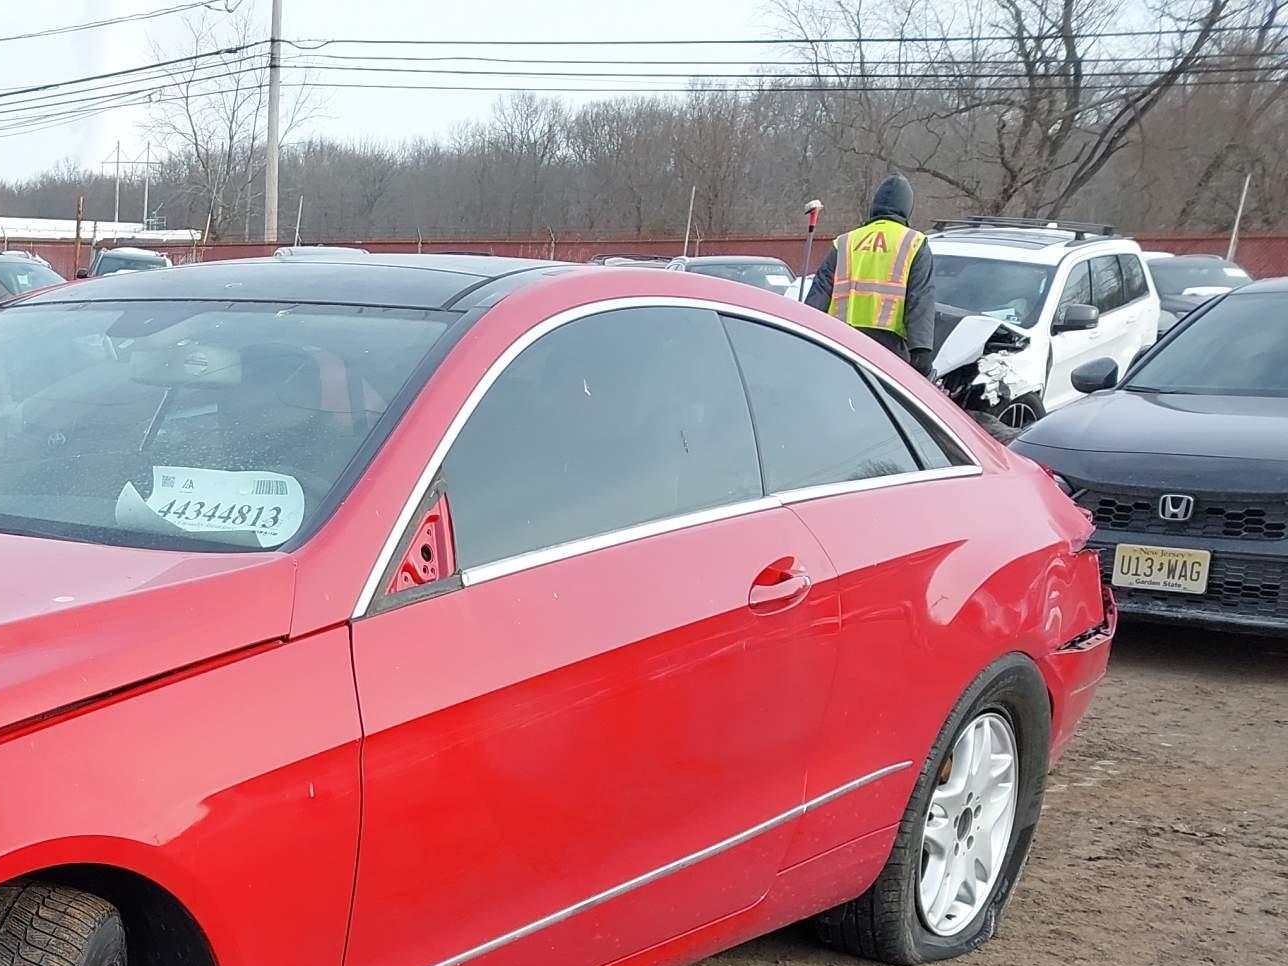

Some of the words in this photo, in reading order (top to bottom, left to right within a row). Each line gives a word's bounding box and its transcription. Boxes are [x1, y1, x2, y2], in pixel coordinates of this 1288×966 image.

[158, 499, 282, 528] 44344813
[1138, 547, 1158, 556] New
[1160, 549, 1185, 559] Jersey
[1135, 578, 1161, 586] Garden
[1162, 580, 1182, 588] State
